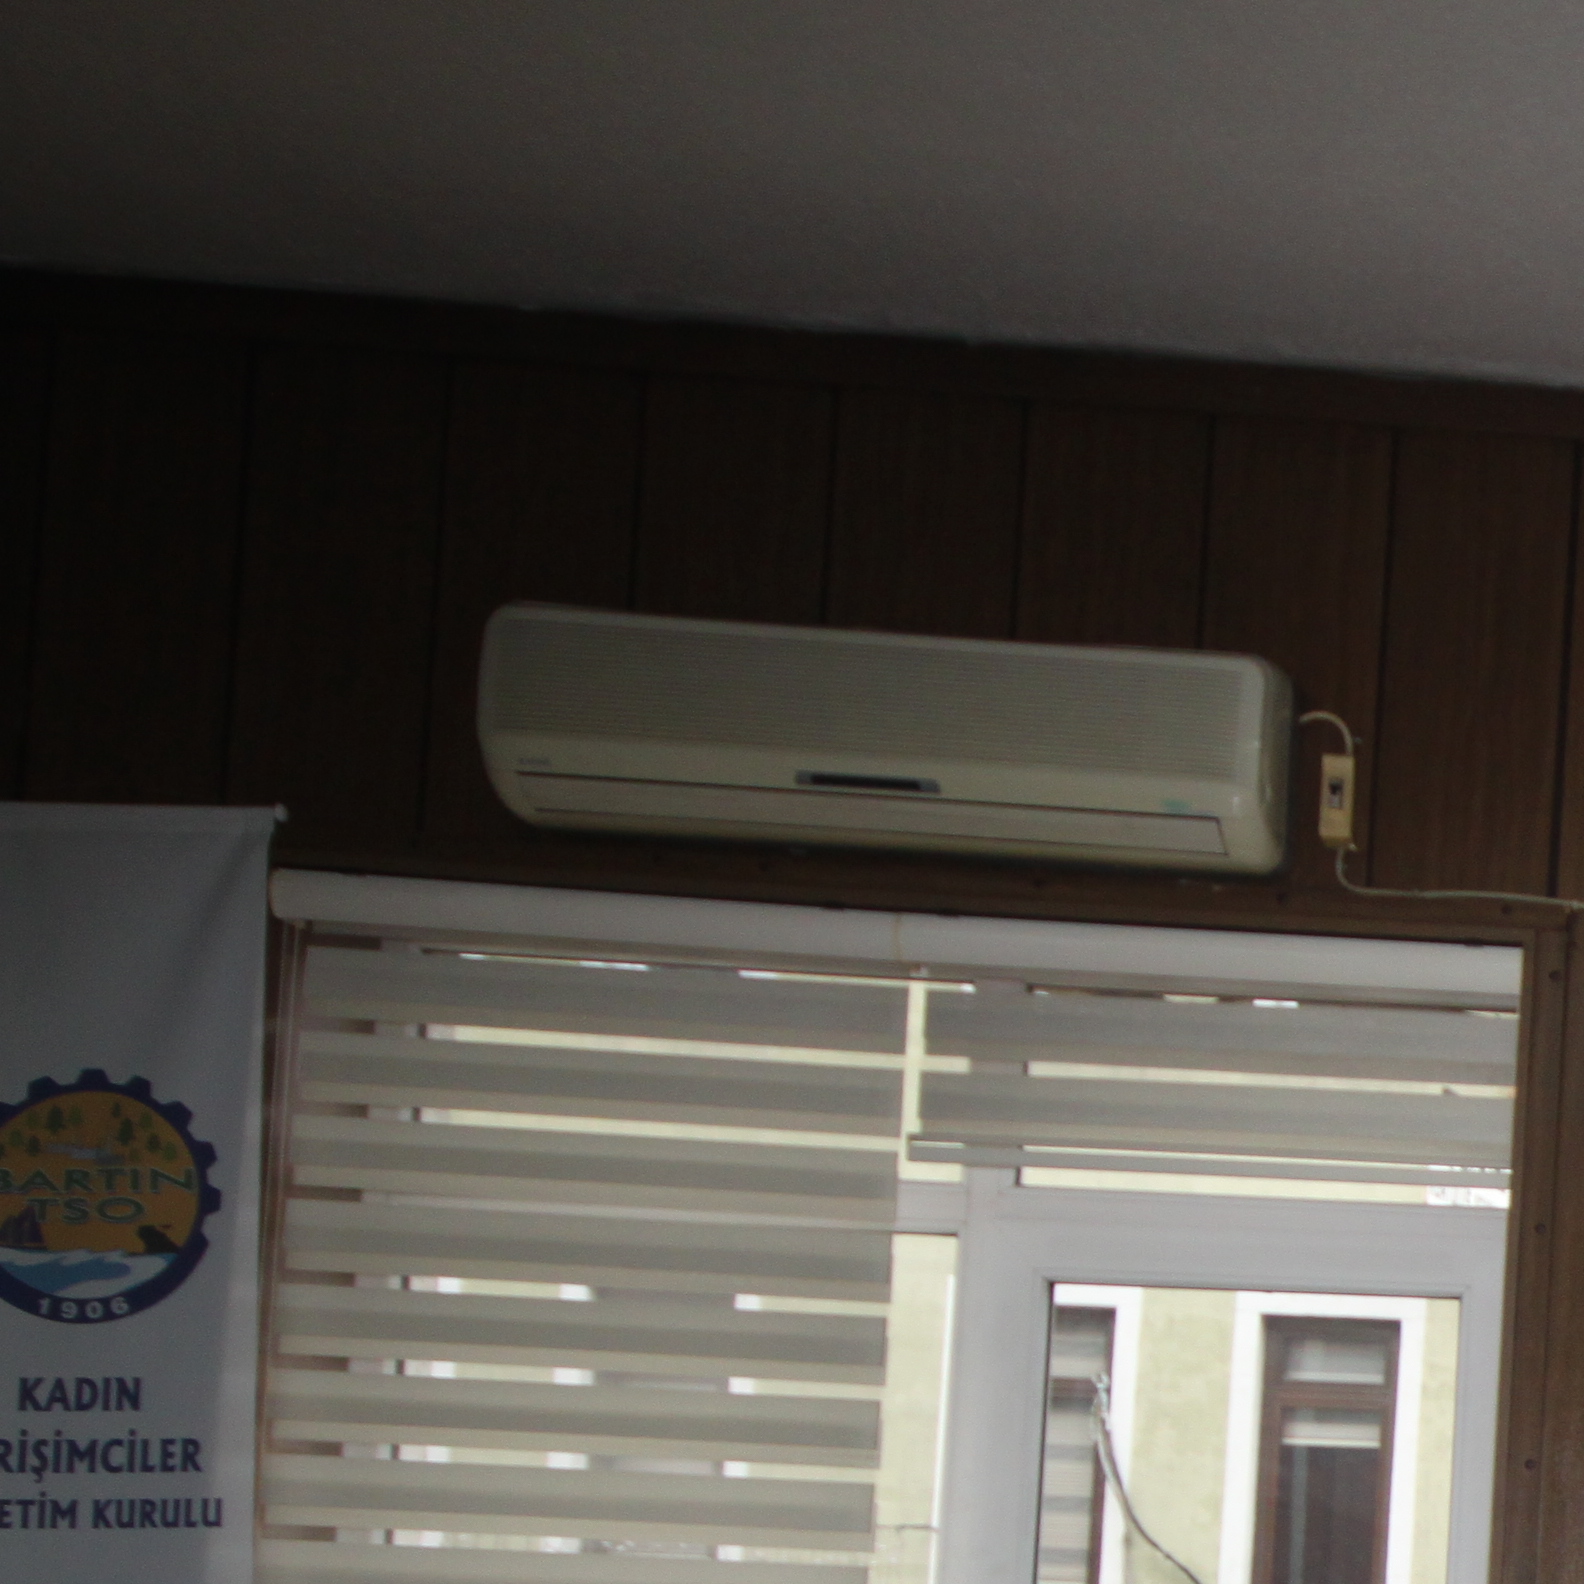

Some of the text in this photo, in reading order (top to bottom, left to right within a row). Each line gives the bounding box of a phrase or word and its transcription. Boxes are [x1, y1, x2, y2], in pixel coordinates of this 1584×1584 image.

[27, 1196, 145, 1224] TSO
[38, 1296, 130, 1320] 1906
[17, 1376, 142, 1412] KADIN
[92, 1497, 222, 1529] KURULU
